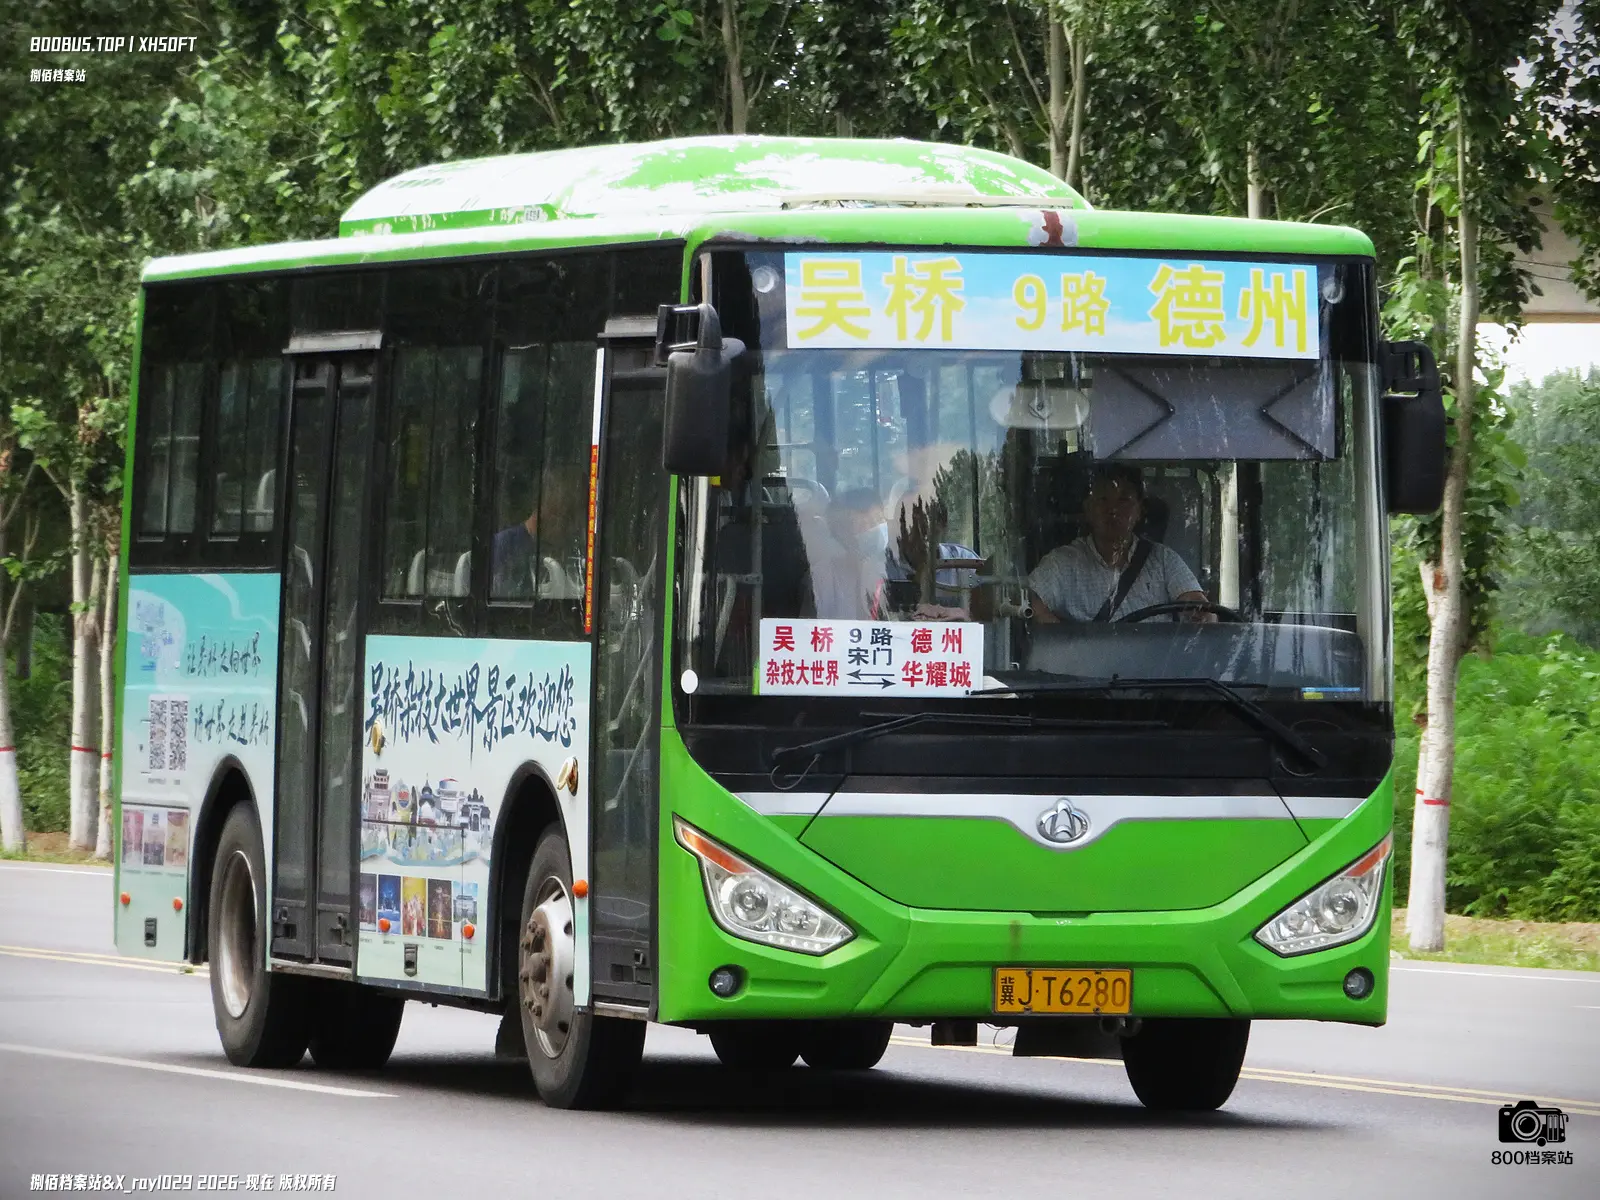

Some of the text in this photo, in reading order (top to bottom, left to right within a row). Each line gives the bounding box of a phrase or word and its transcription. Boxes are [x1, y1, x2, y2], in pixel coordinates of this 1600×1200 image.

[794, 255, 1307, 353] 吴桥 9路 德州
[773, 626, 834, 653] 吴桥
[910, 627, 963, 654] 德州
[847, 647, 893, 666] 宋门
[766, 659, 972, 688] 杂技大世界 华耀城
[365, 660, 576, 764] 吴桥杂技大世界景区欢迎您
